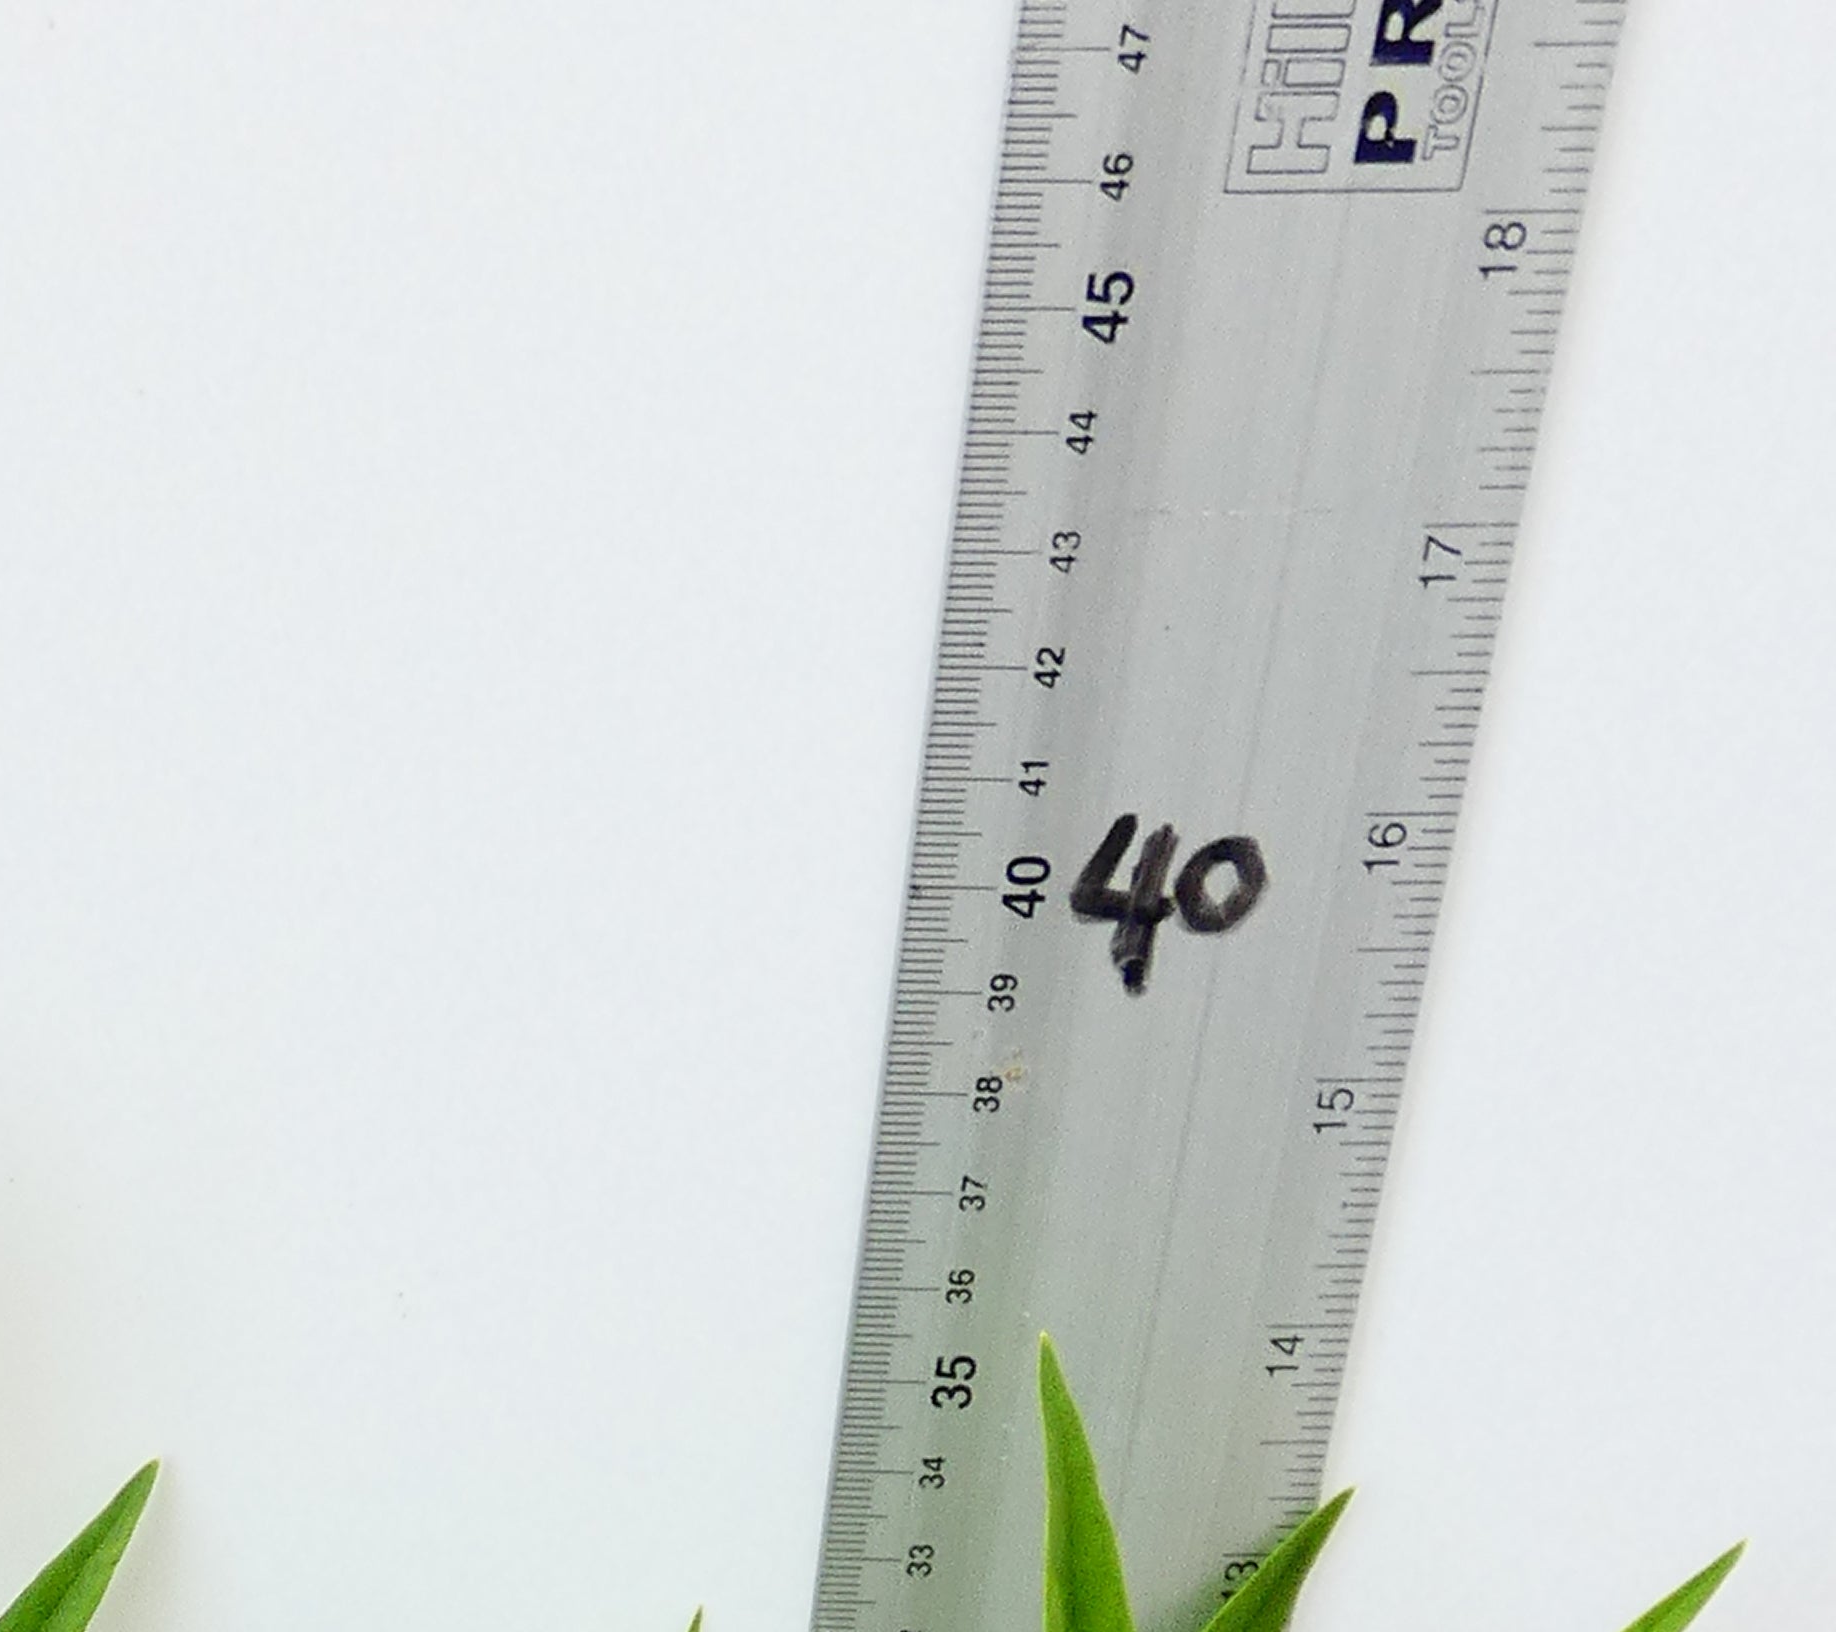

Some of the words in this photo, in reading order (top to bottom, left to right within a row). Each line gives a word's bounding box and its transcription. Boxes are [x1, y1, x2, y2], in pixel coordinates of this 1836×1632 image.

[1117, 24, 1150, 74] 47
[1099, 152, 1134, 202] 46
[1478, 221, 1527, 279] 18
[1081, 271, 1135, 345] 45
[1065, 410, 1098, 455] 44
[1049, 531, 1081, 574] 43
[1418, 535, 1462, 589] 17
[1033, 647, 1066, 689] 42
[1018, 761, 1050, 797] 41
[1361, 822, 1408, 872] 16
[1001, 855, 1052, 919] 40
[1070, 813, 1269, 997] 40
[986, 973, 1019, 1013] 39
[972, 1075, 1004, 1114] 38
[1312, 1087, 1355, 1135] 15
[958, 1174, 987, 1212] 37
[945, 1268, 976, 1305] 36
[1264, 1335, 1304, 1377] 14
[930, 1355, 977, 1410] 35
[918, 1456, 946, 1490] 34
[905, 1544, 935, 1578] 33
